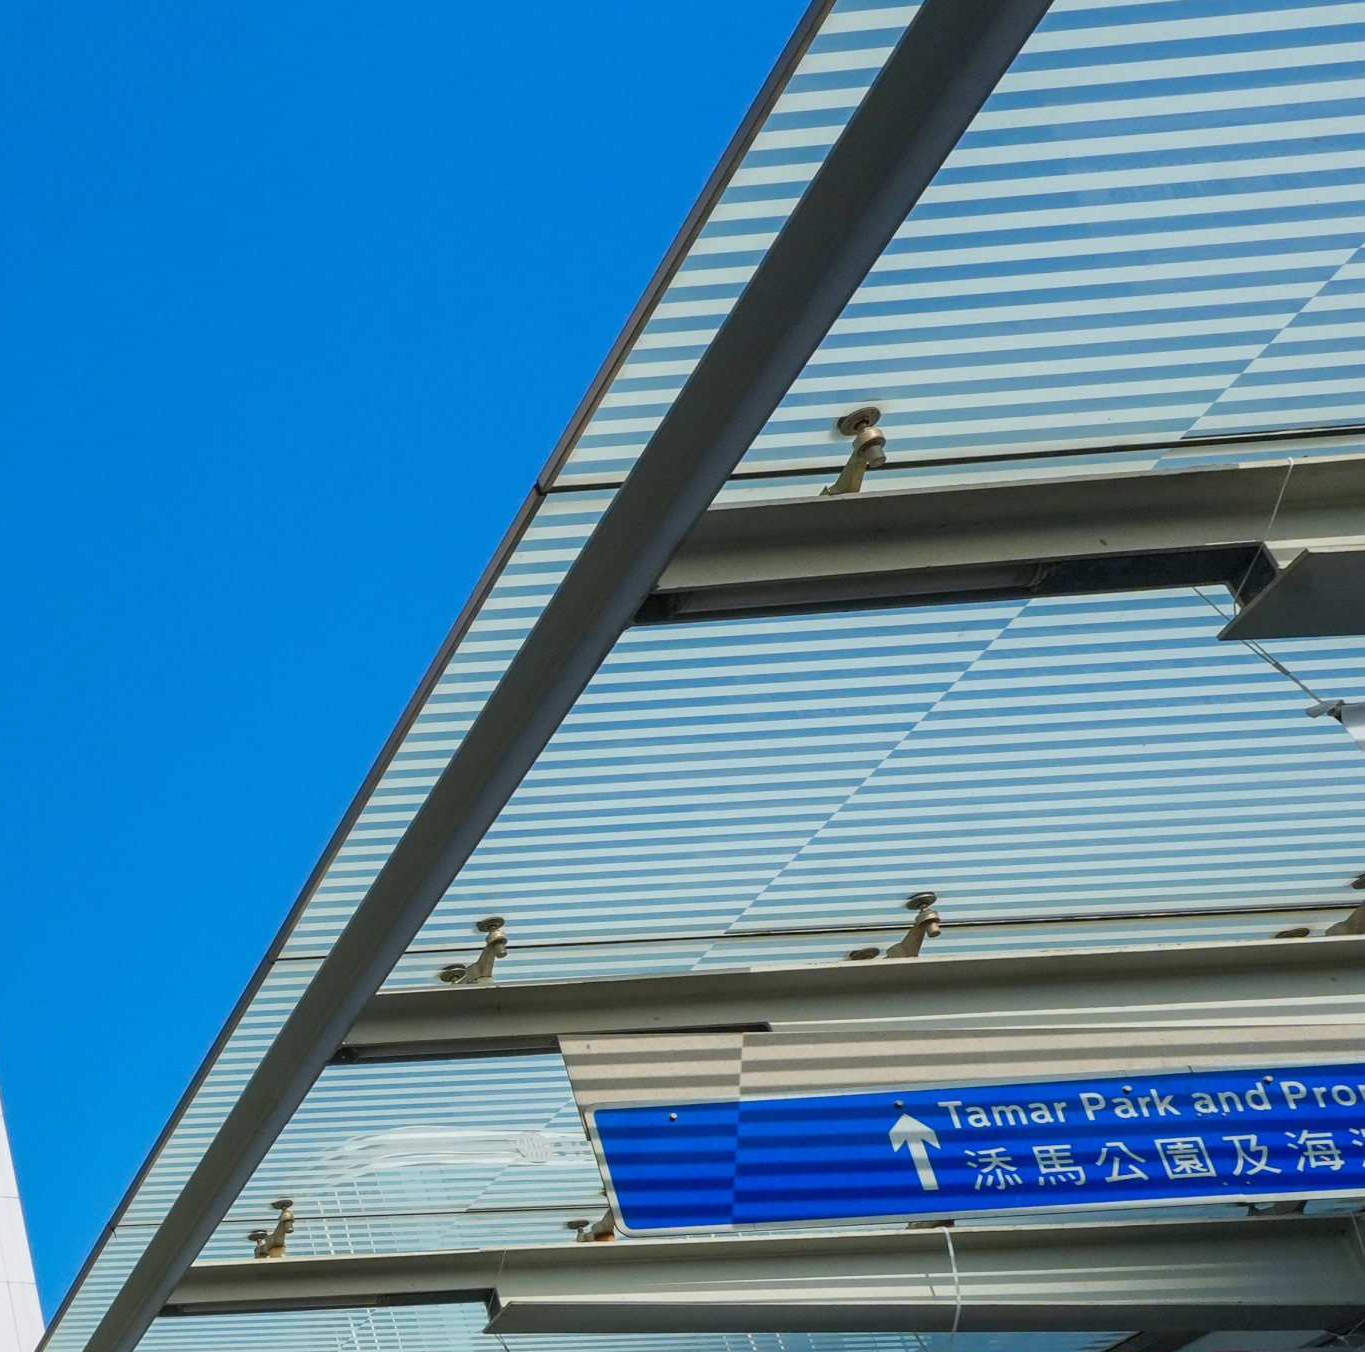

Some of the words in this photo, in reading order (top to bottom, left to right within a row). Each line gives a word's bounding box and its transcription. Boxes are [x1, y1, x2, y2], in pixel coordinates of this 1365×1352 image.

[938, 1101, 1067, 1129] Tamar
[1079, 1088, 1181, 1121] Park
[1193, 1082, 1272, 1115] and
[1280, 1080, 1365, 1110] Pro
[964, 1128, 1365, 1191] 添馬公園及海
